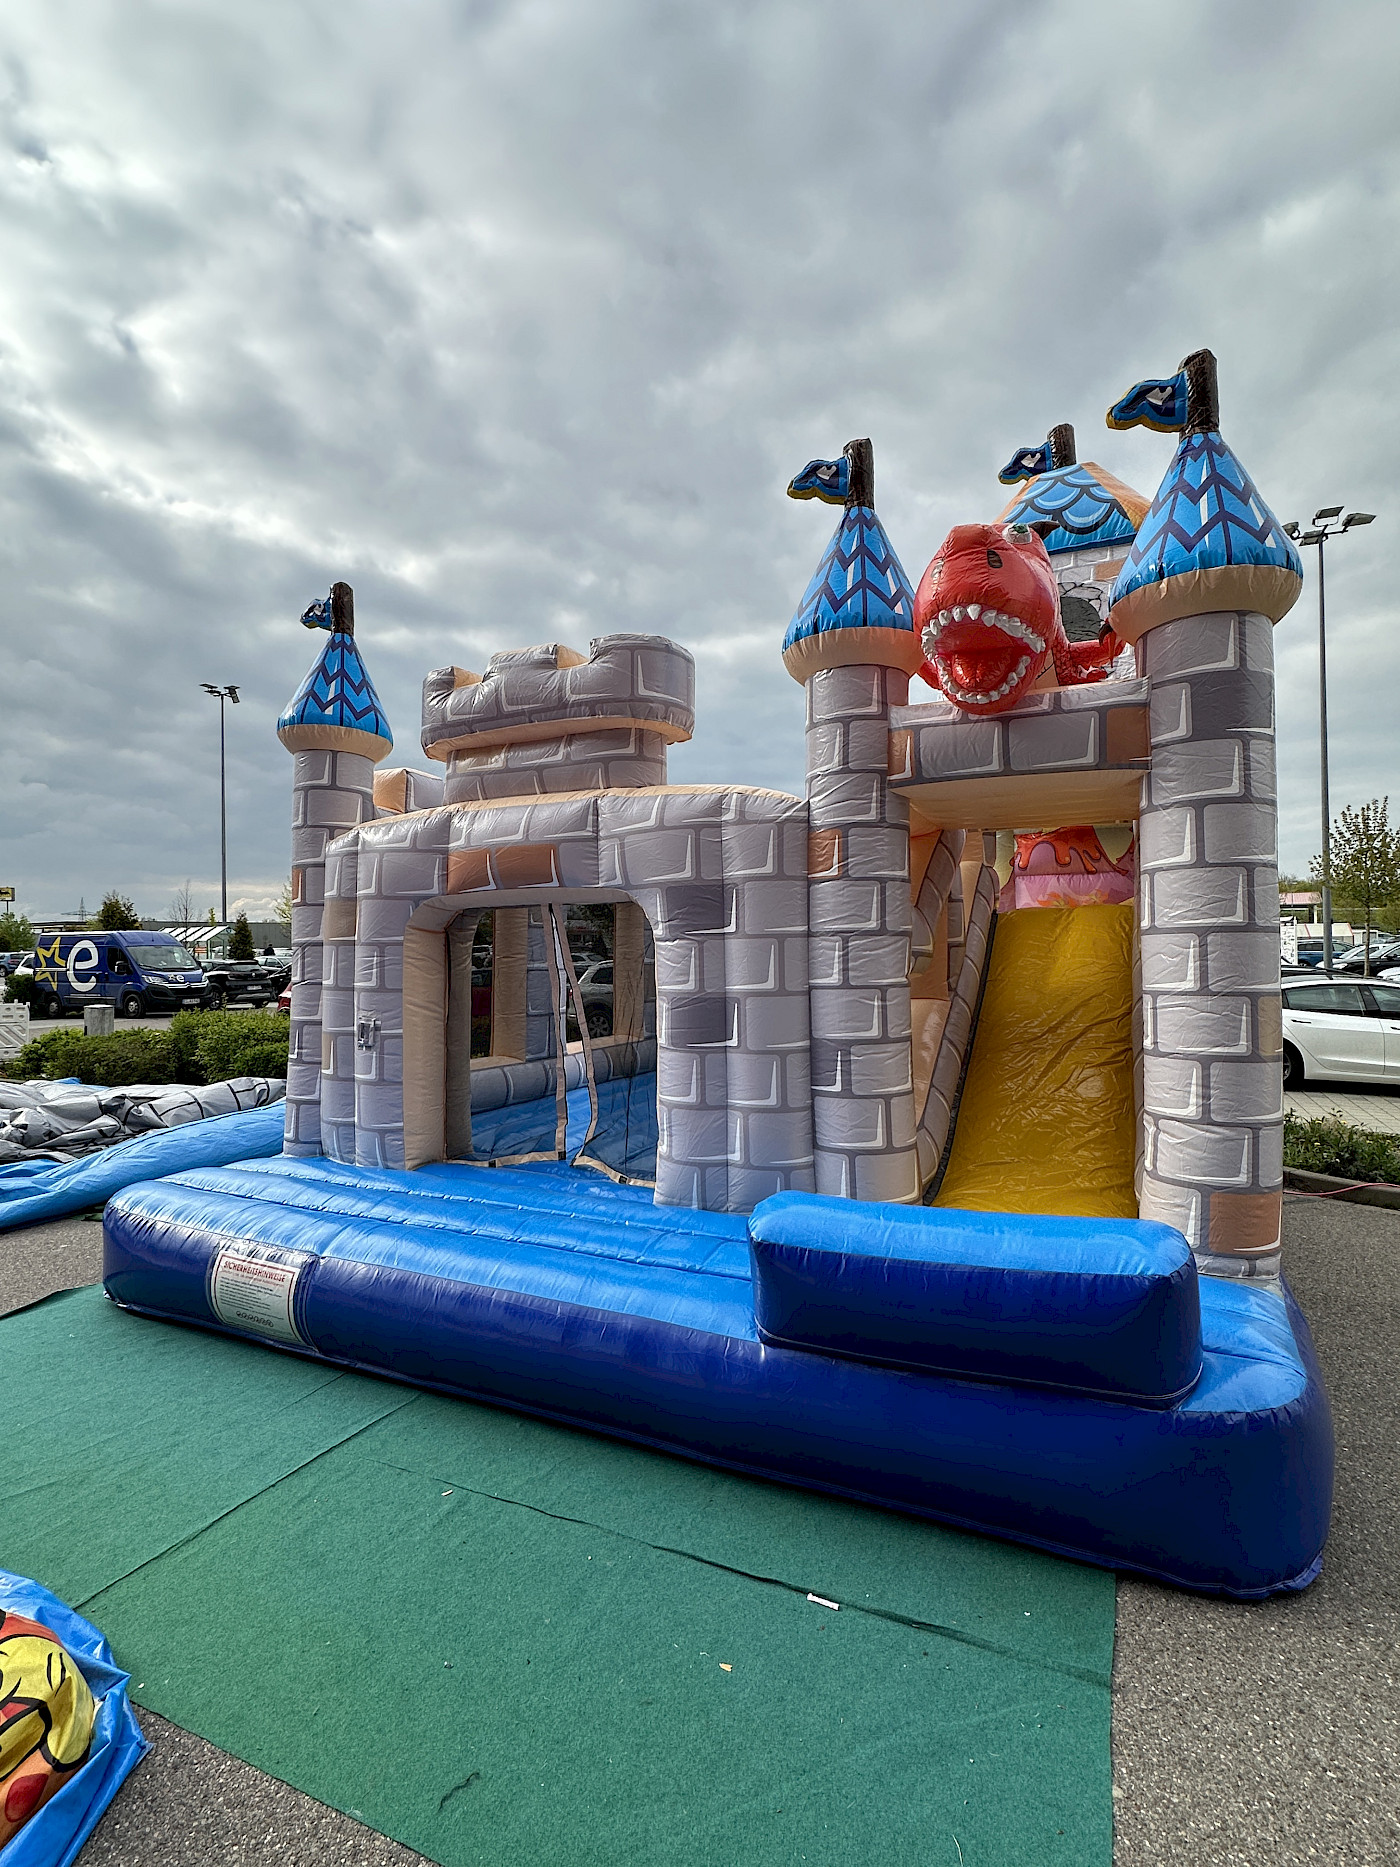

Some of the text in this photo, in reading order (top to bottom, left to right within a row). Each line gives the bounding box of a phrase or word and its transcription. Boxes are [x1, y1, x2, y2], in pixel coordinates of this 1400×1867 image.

[67, 940, 99, 992] e
[177, 974, 185, 983] e
[223, 1261, 285, 1282] SICHERHEITSHINWEISE
